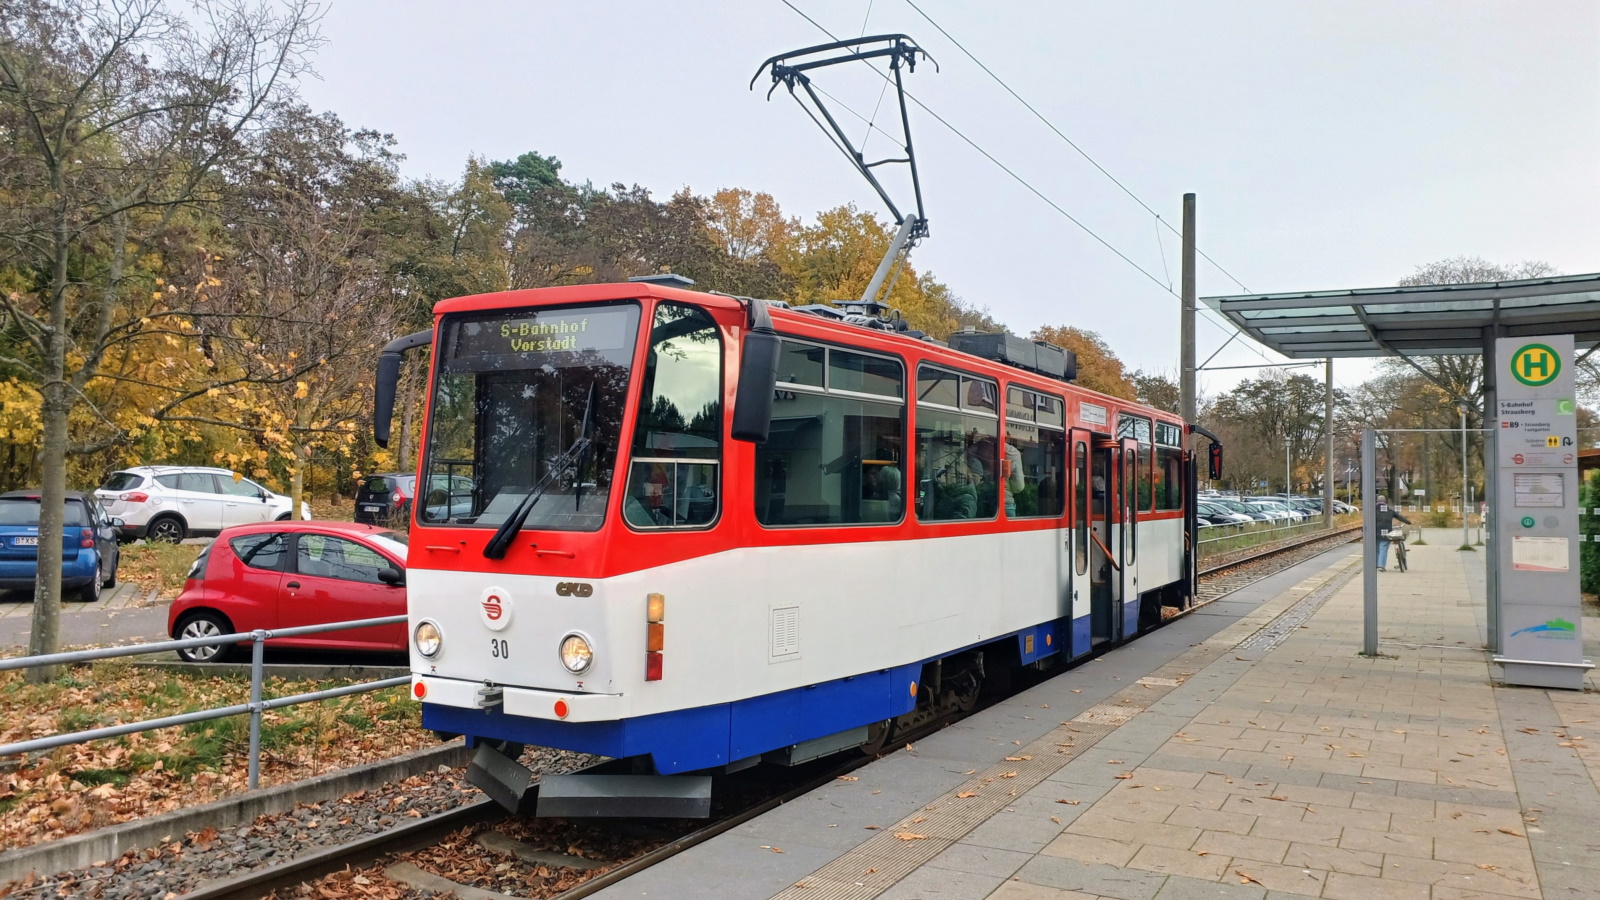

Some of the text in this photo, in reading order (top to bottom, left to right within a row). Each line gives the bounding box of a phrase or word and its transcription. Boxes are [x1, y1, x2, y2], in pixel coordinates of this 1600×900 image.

[501, 319, 588, 336] S-Bahnhof
[511, 336, 577, 352] Vorstadt
[1523, 353, 1548, 377] H
[491, 638, 508, 659] 30
